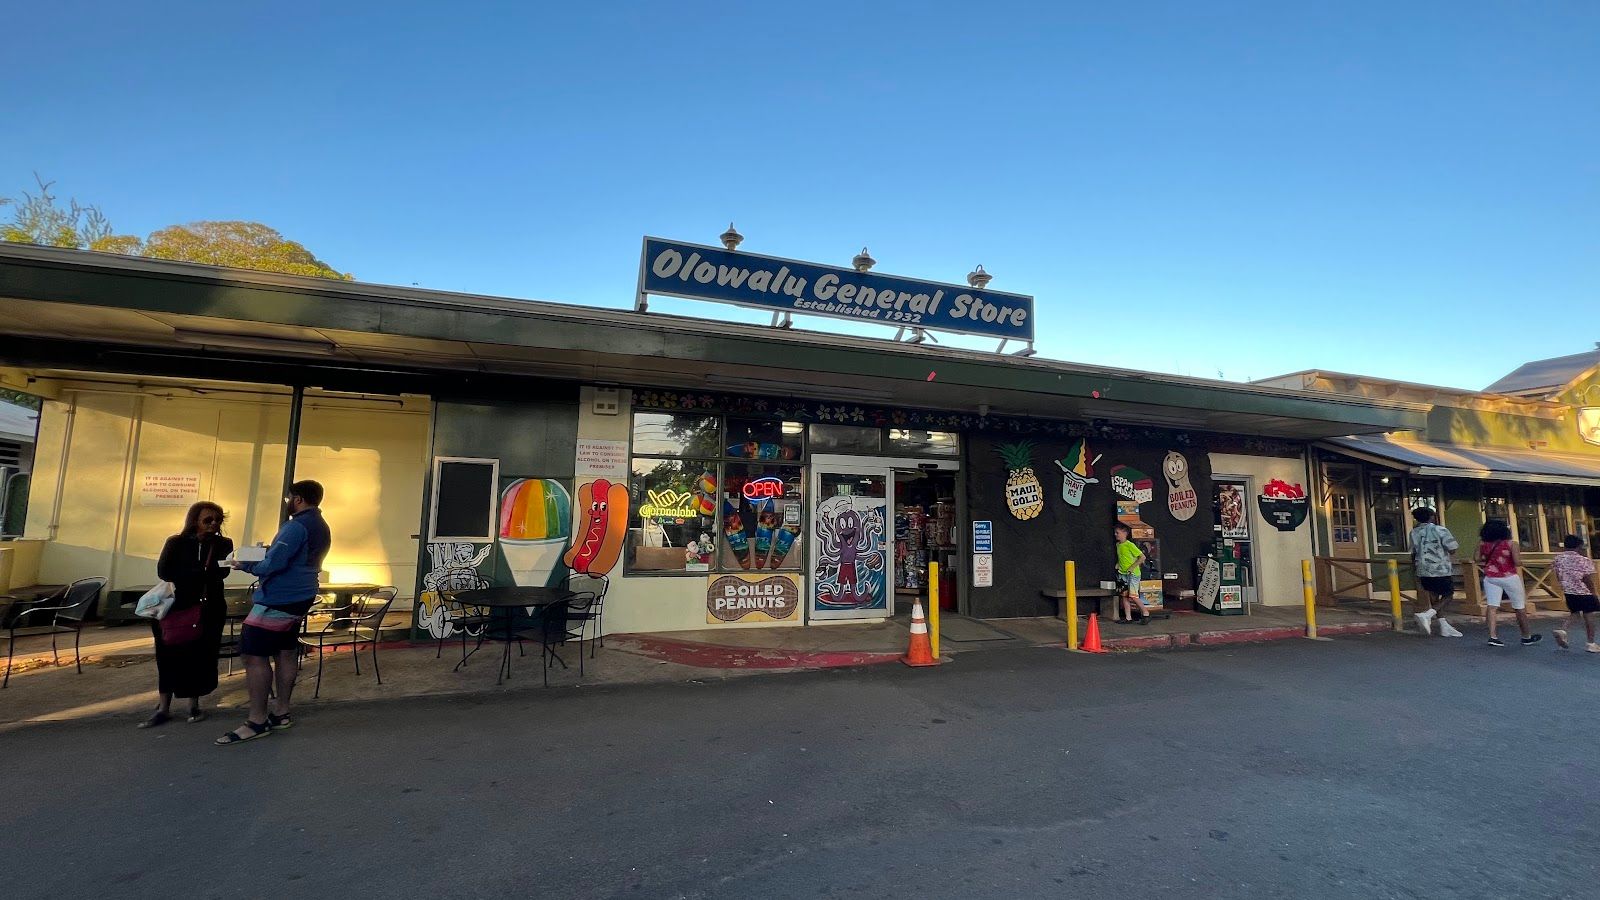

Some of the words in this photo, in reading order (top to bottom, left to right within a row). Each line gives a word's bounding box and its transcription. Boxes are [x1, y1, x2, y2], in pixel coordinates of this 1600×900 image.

[652, 248, 808, 298] Olowalu
[813, 273, 945, 316] General
[949, 294, 1027, 327] Store
[793, 297, 881, 318] Established
[884, 310, 922, 323] 1932
[743, 481, 783, 497] OPEN
[1065, 478, 1083, 492] SHAVE
[1114, 475, 1134, 490] SPAM
[1010, 484, 1037, 497] MAUI
[1067, 488, 1077, 498] ICE
[1169, 489, 1195, 503] BOILED
[1012, 494, 1039, 507] GOLD
[1170, 499, 1197, 512] PEANUTS
[724, 584, 784, 597] BOILED
[715, 596, 786, 610] PEANUTS
